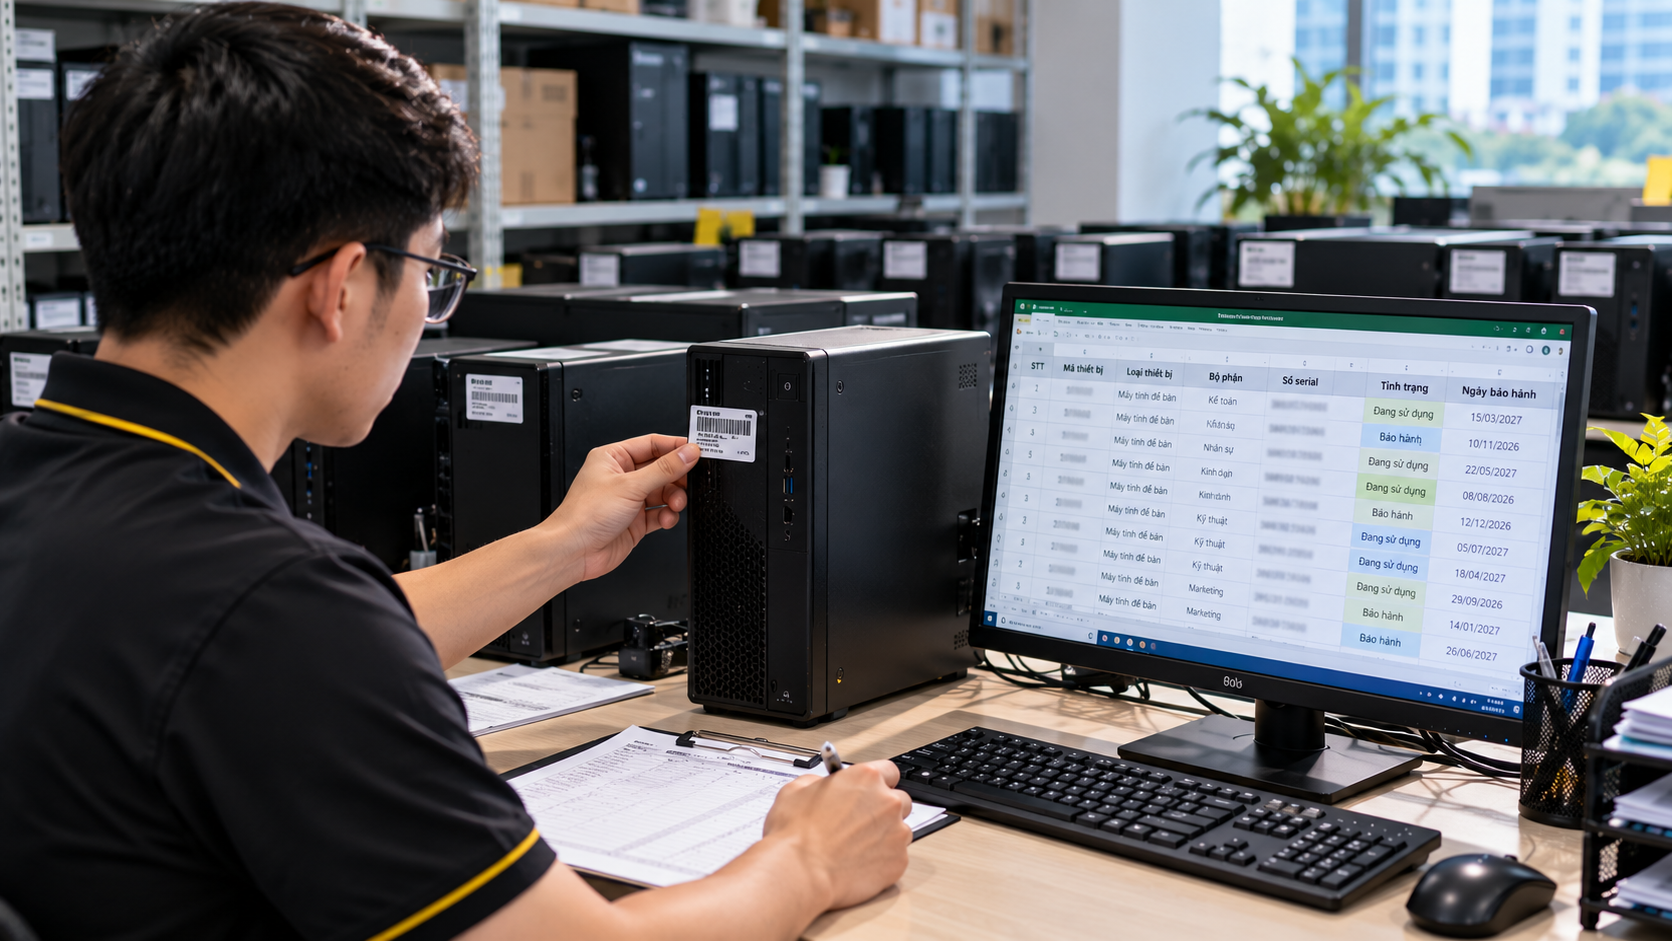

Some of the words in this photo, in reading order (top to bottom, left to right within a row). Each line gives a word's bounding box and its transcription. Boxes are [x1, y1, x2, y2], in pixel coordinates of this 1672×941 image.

[1031, 362, 1044, 370] STT
[1295, 378, 1318, 386] serial
[1404, 383, 1429, 395] trạng
[1221, 397, 1237, 405] toán
[1374, 406, 1396, 418] Đang
[1399, 408, 1409, 417] sử
[1412, 409, 1434, 421] dụng
[1471, 413, 1522, 424] 15/03/2027
[1468, 439, 1520, 451] 10/11/2026
[1201, 467, 1217, 476] Kinh
[1369, 457, 1391, 469] Đang
[1393, 459, 1404, 468] sử
[1406, 460, 1429, 472] dụng
[1465, 465, 1517, 478] 22/05/2027
[1366, 482, 1388, 494] Đang
[1391, 485, 1401, 493] sử
[1404, 486, 1426, 498] dụng
[1461, 517, 1512, 530] 12/12/2026
[1361, 532, 1383, 545] Đang
[1386, 534, 1397, 544] sử
[1398, 536, 1421, 548] dụng
[1457, 543, 1508, 557] 05/07/2027
[1358, 557, 1381, 570] Đang
[1383, 560, 1395, 569] sử
[1396, 561, 1418, 574] dụng
[1455, 568, 1506, 582] 18/04/2027
[1189, 584, 1224, 598] Marketing
[1357, 582, 1379, 595] Đang
[1381, 585, 1392, 594] sử
[1394, 586, 1416, 600] dụng
[1451, 594, 1503, 609] 29/09/2026
[1186, 607, 1221, 621] Marketing
[1450, 620, 1500, 635] 14/01/2027
[1446, 646, 1498, 662] 26/06/2027
